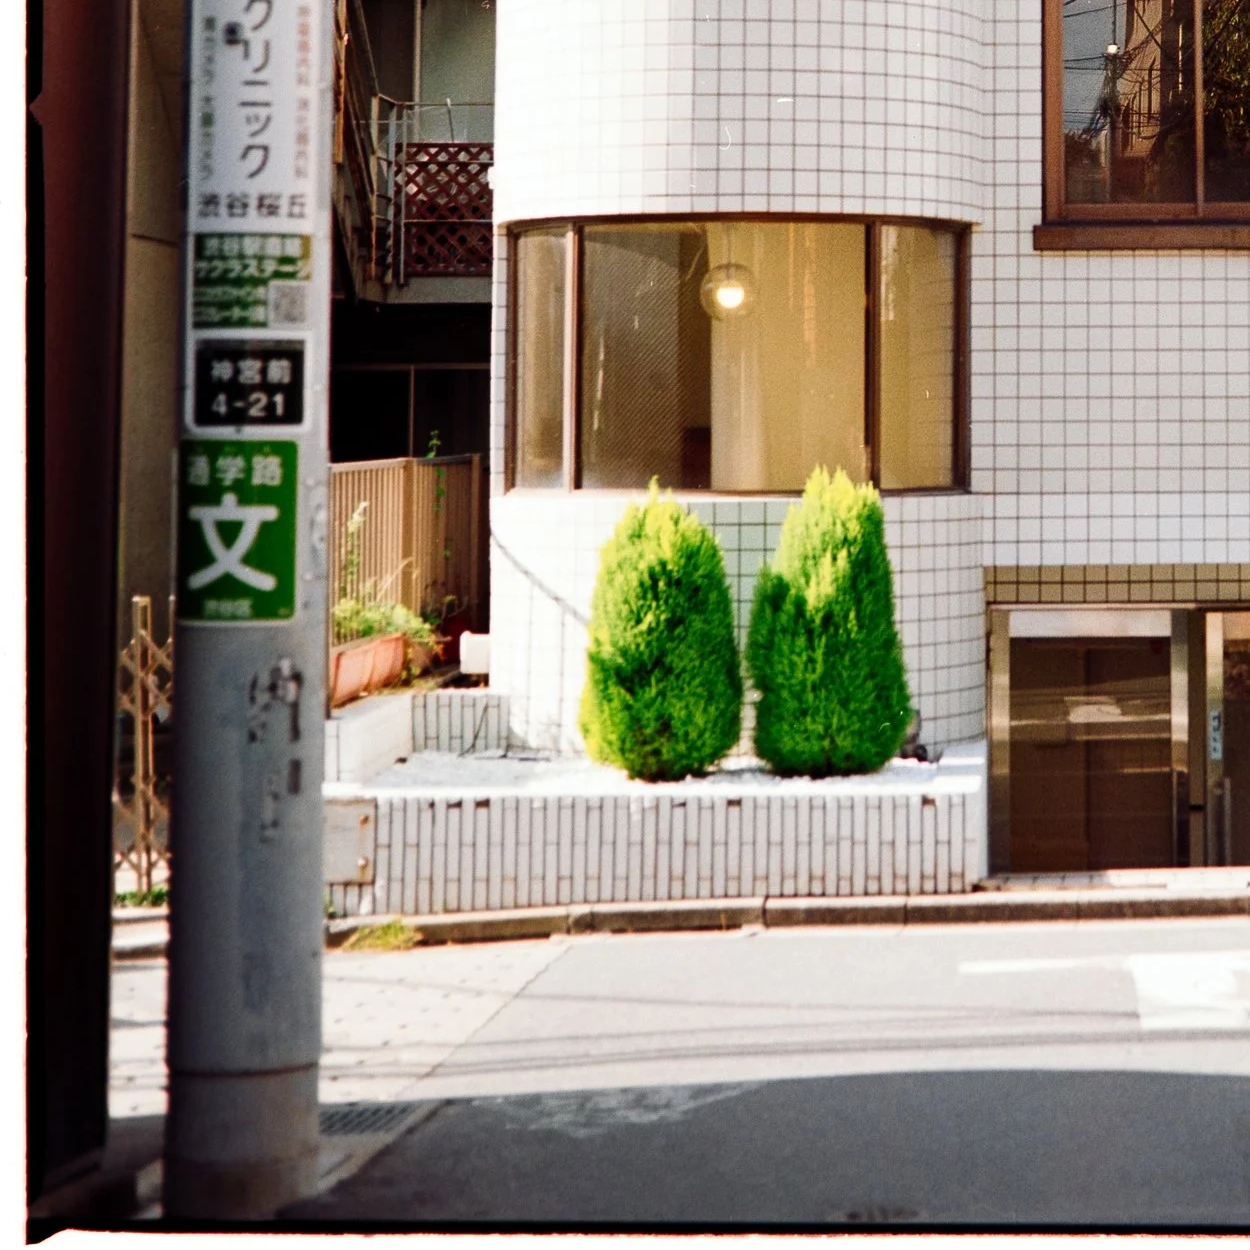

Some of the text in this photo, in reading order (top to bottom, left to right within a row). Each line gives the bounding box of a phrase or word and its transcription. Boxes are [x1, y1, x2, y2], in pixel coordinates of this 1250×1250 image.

[198, 193, 306, 219] 渋谷桜丘
[211, 358, 292, 384] 神宮前
[212, 391, 285, 417] 4-21
[187, 454, 282, 487] 通学路
[187, 492, 280, 592] 文
